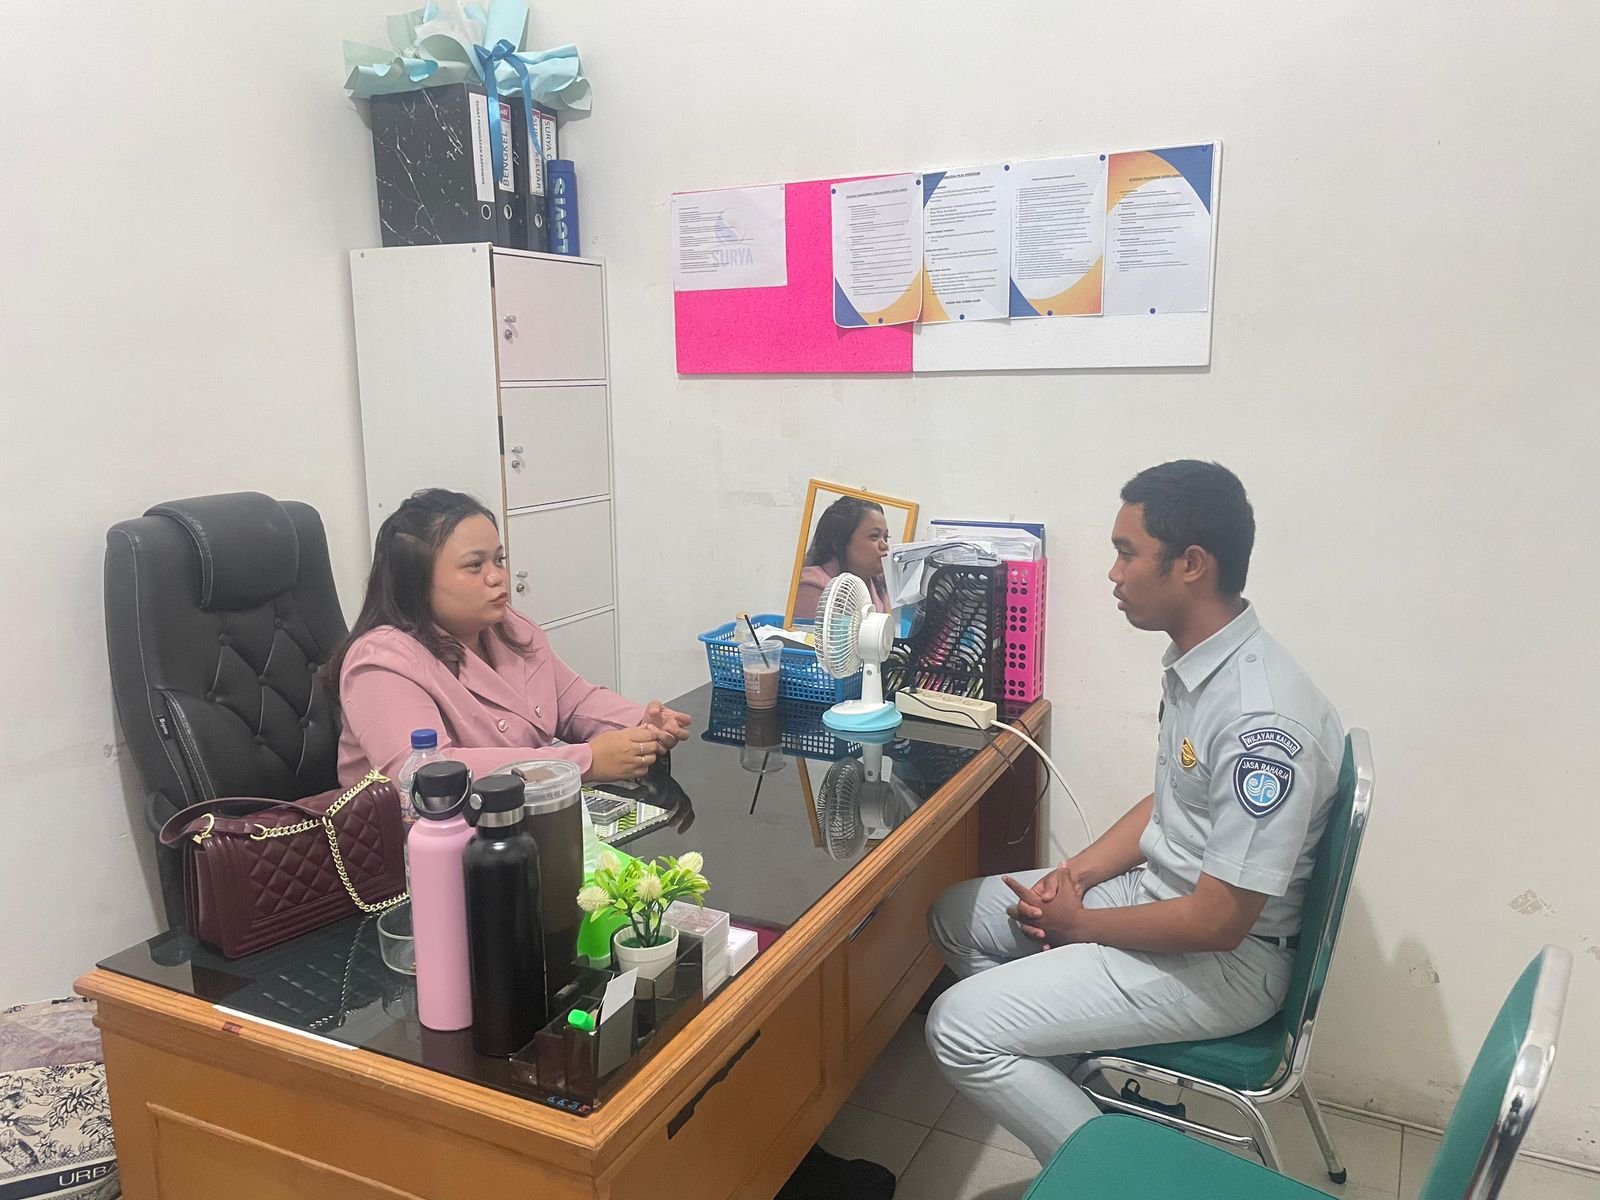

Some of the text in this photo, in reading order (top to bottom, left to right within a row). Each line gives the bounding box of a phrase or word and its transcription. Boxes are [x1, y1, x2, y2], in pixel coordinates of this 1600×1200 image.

[544, 120, 552, 151] SURYA
[502, 130, 511, 187] BENGKEL
[712, 248, 753, 267] SURYA
[1244, 732, 1298, 754] WILAYAH KALBAR
[1241, 761, 1289, 780] JASA RAHARJA
